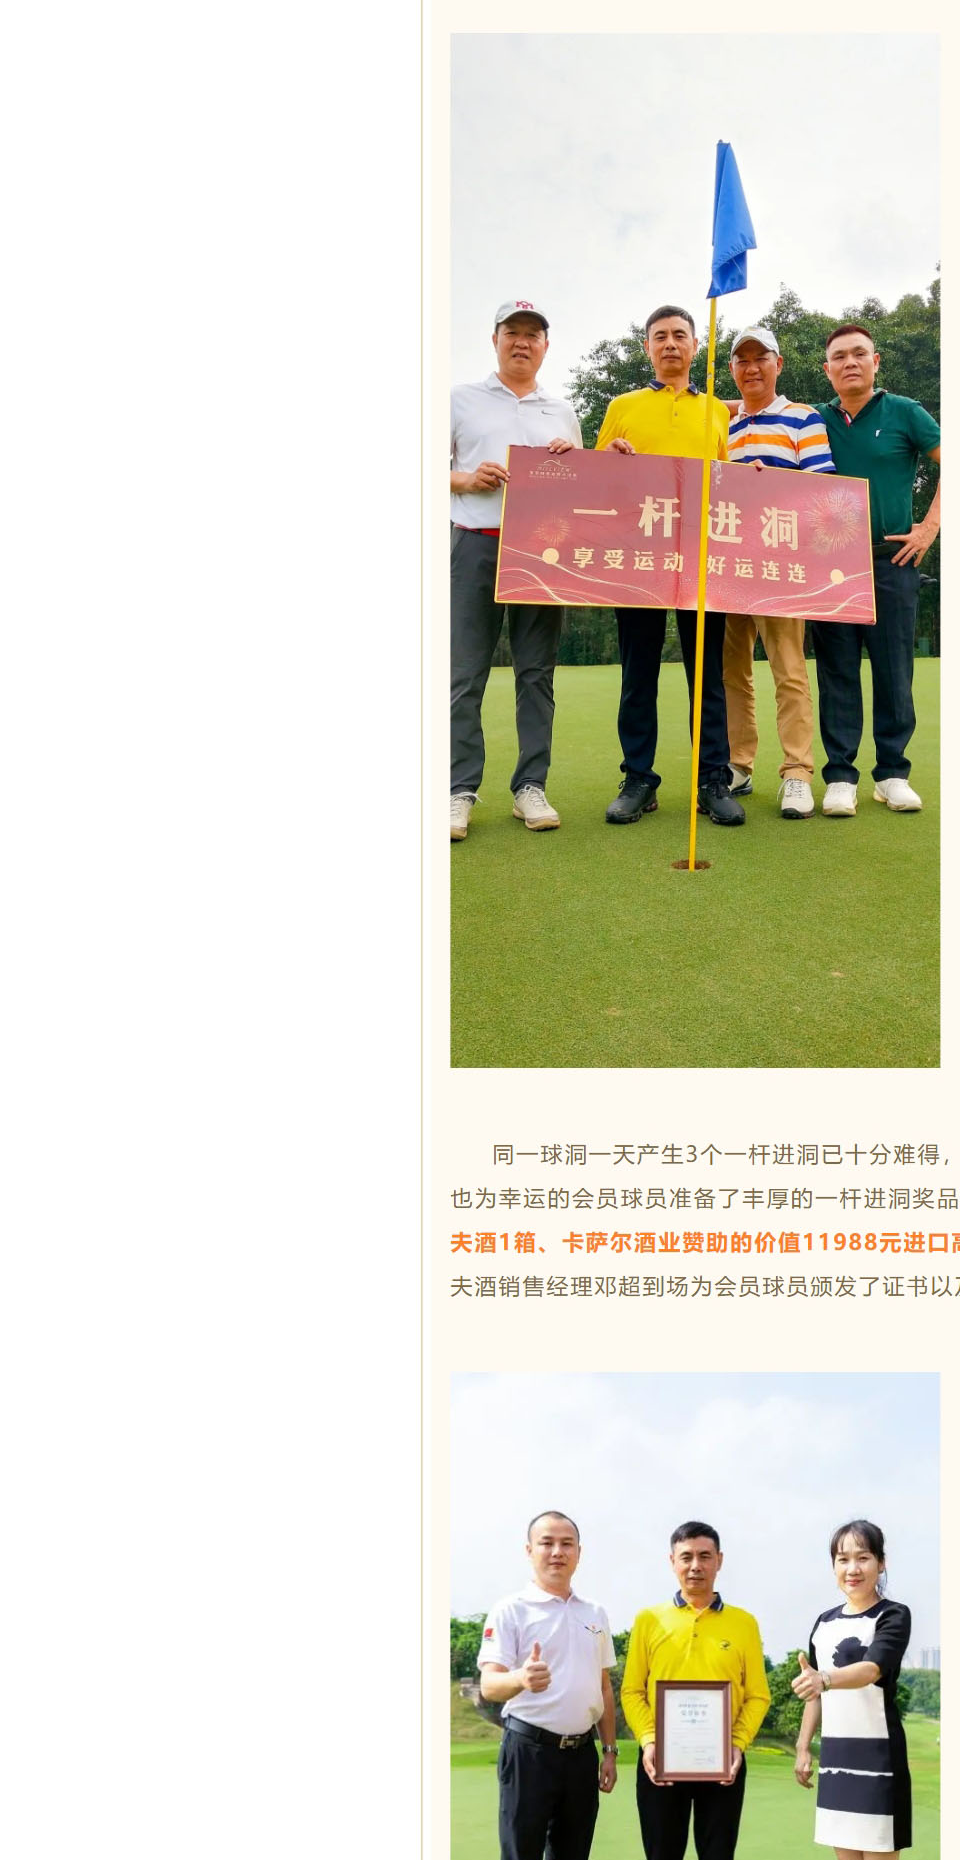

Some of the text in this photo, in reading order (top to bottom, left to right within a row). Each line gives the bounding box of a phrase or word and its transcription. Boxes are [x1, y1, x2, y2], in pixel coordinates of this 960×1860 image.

[573, 495, 799, 551] 一杆进洞
[572, 547, 807, 584] 享受运动 好运连连
